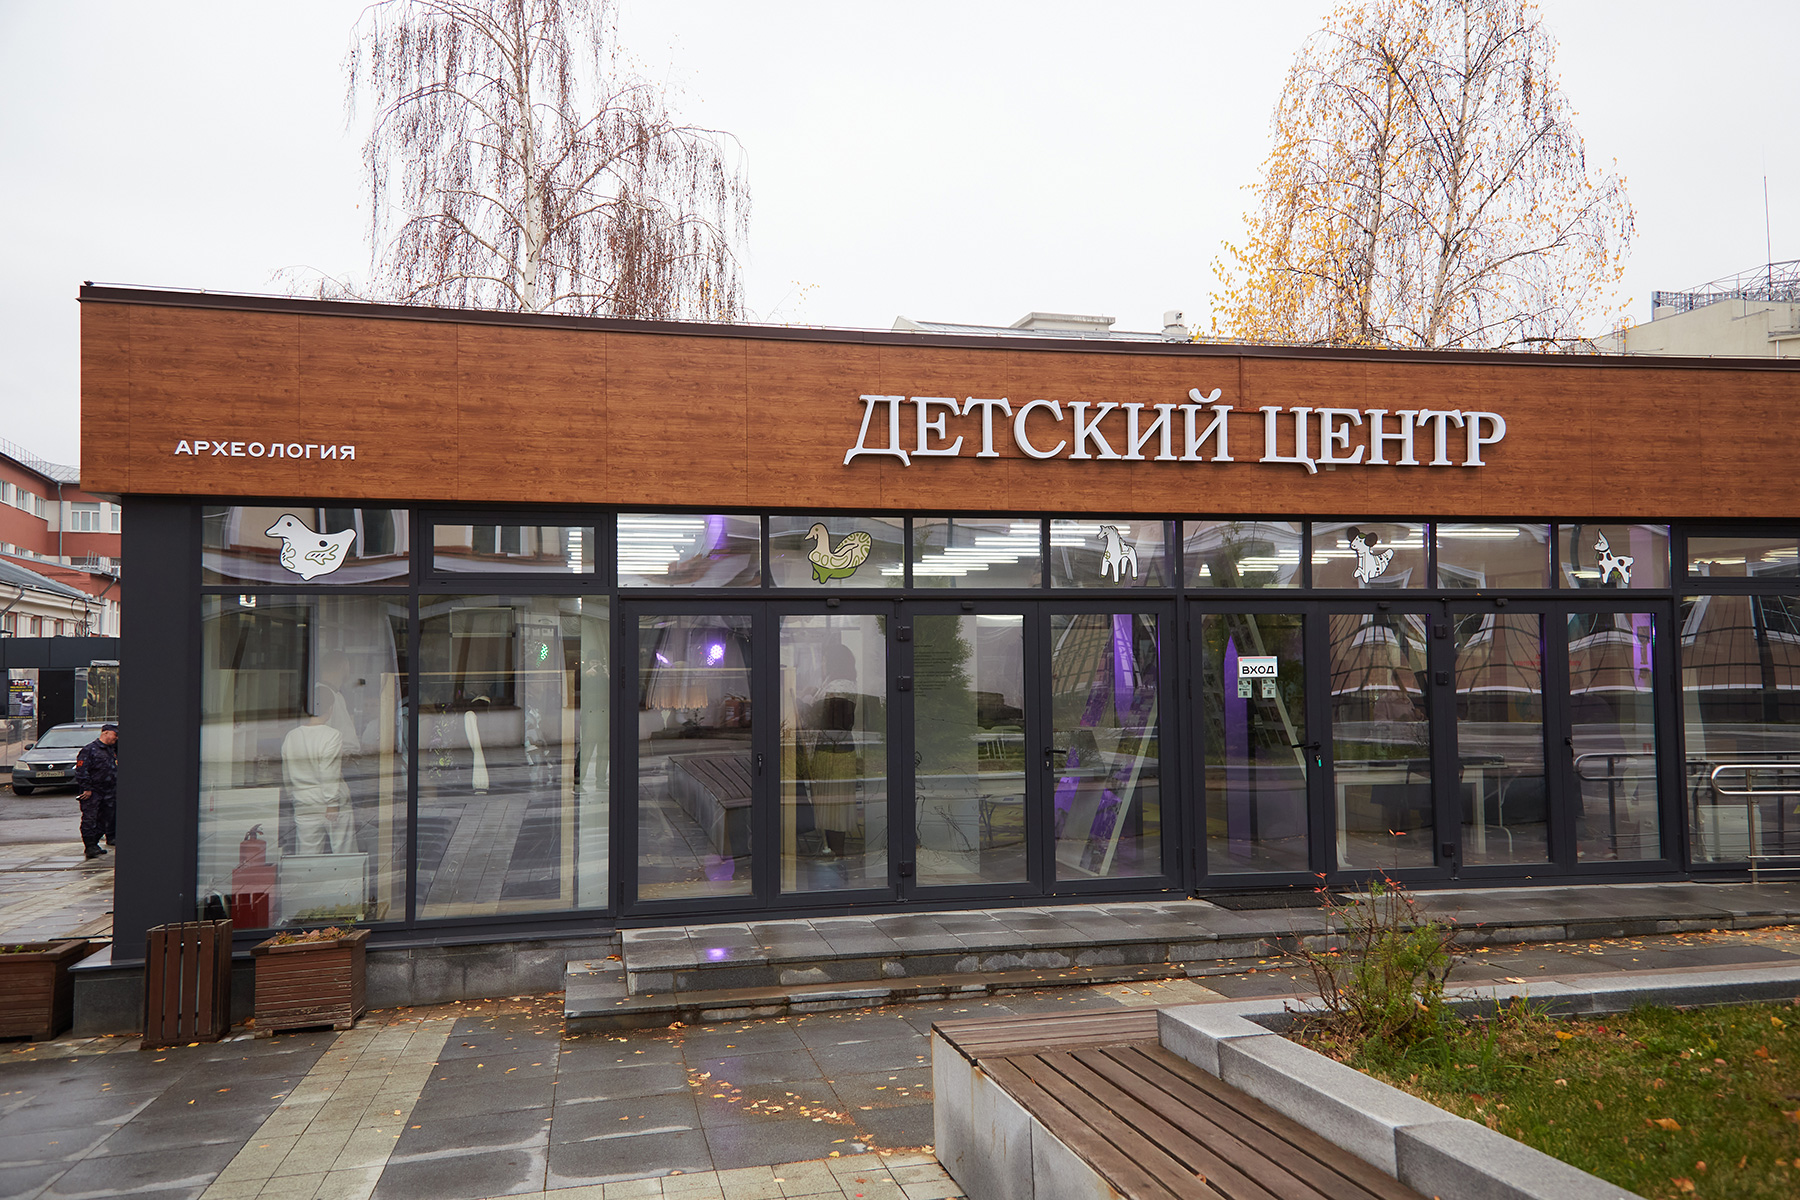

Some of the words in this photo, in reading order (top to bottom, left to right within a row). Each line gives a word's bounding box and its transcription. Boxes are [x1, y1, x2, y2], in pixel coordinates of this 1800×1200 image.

[842, 387, 1234, 467] ДЕТСКИЙ
[1259, 406, 1507, 475] ЦЕНТР
[174, 440, 356, 460] АРХЕОЛОГИЯ
[1242, 665, 1275, 675] ВХОД
